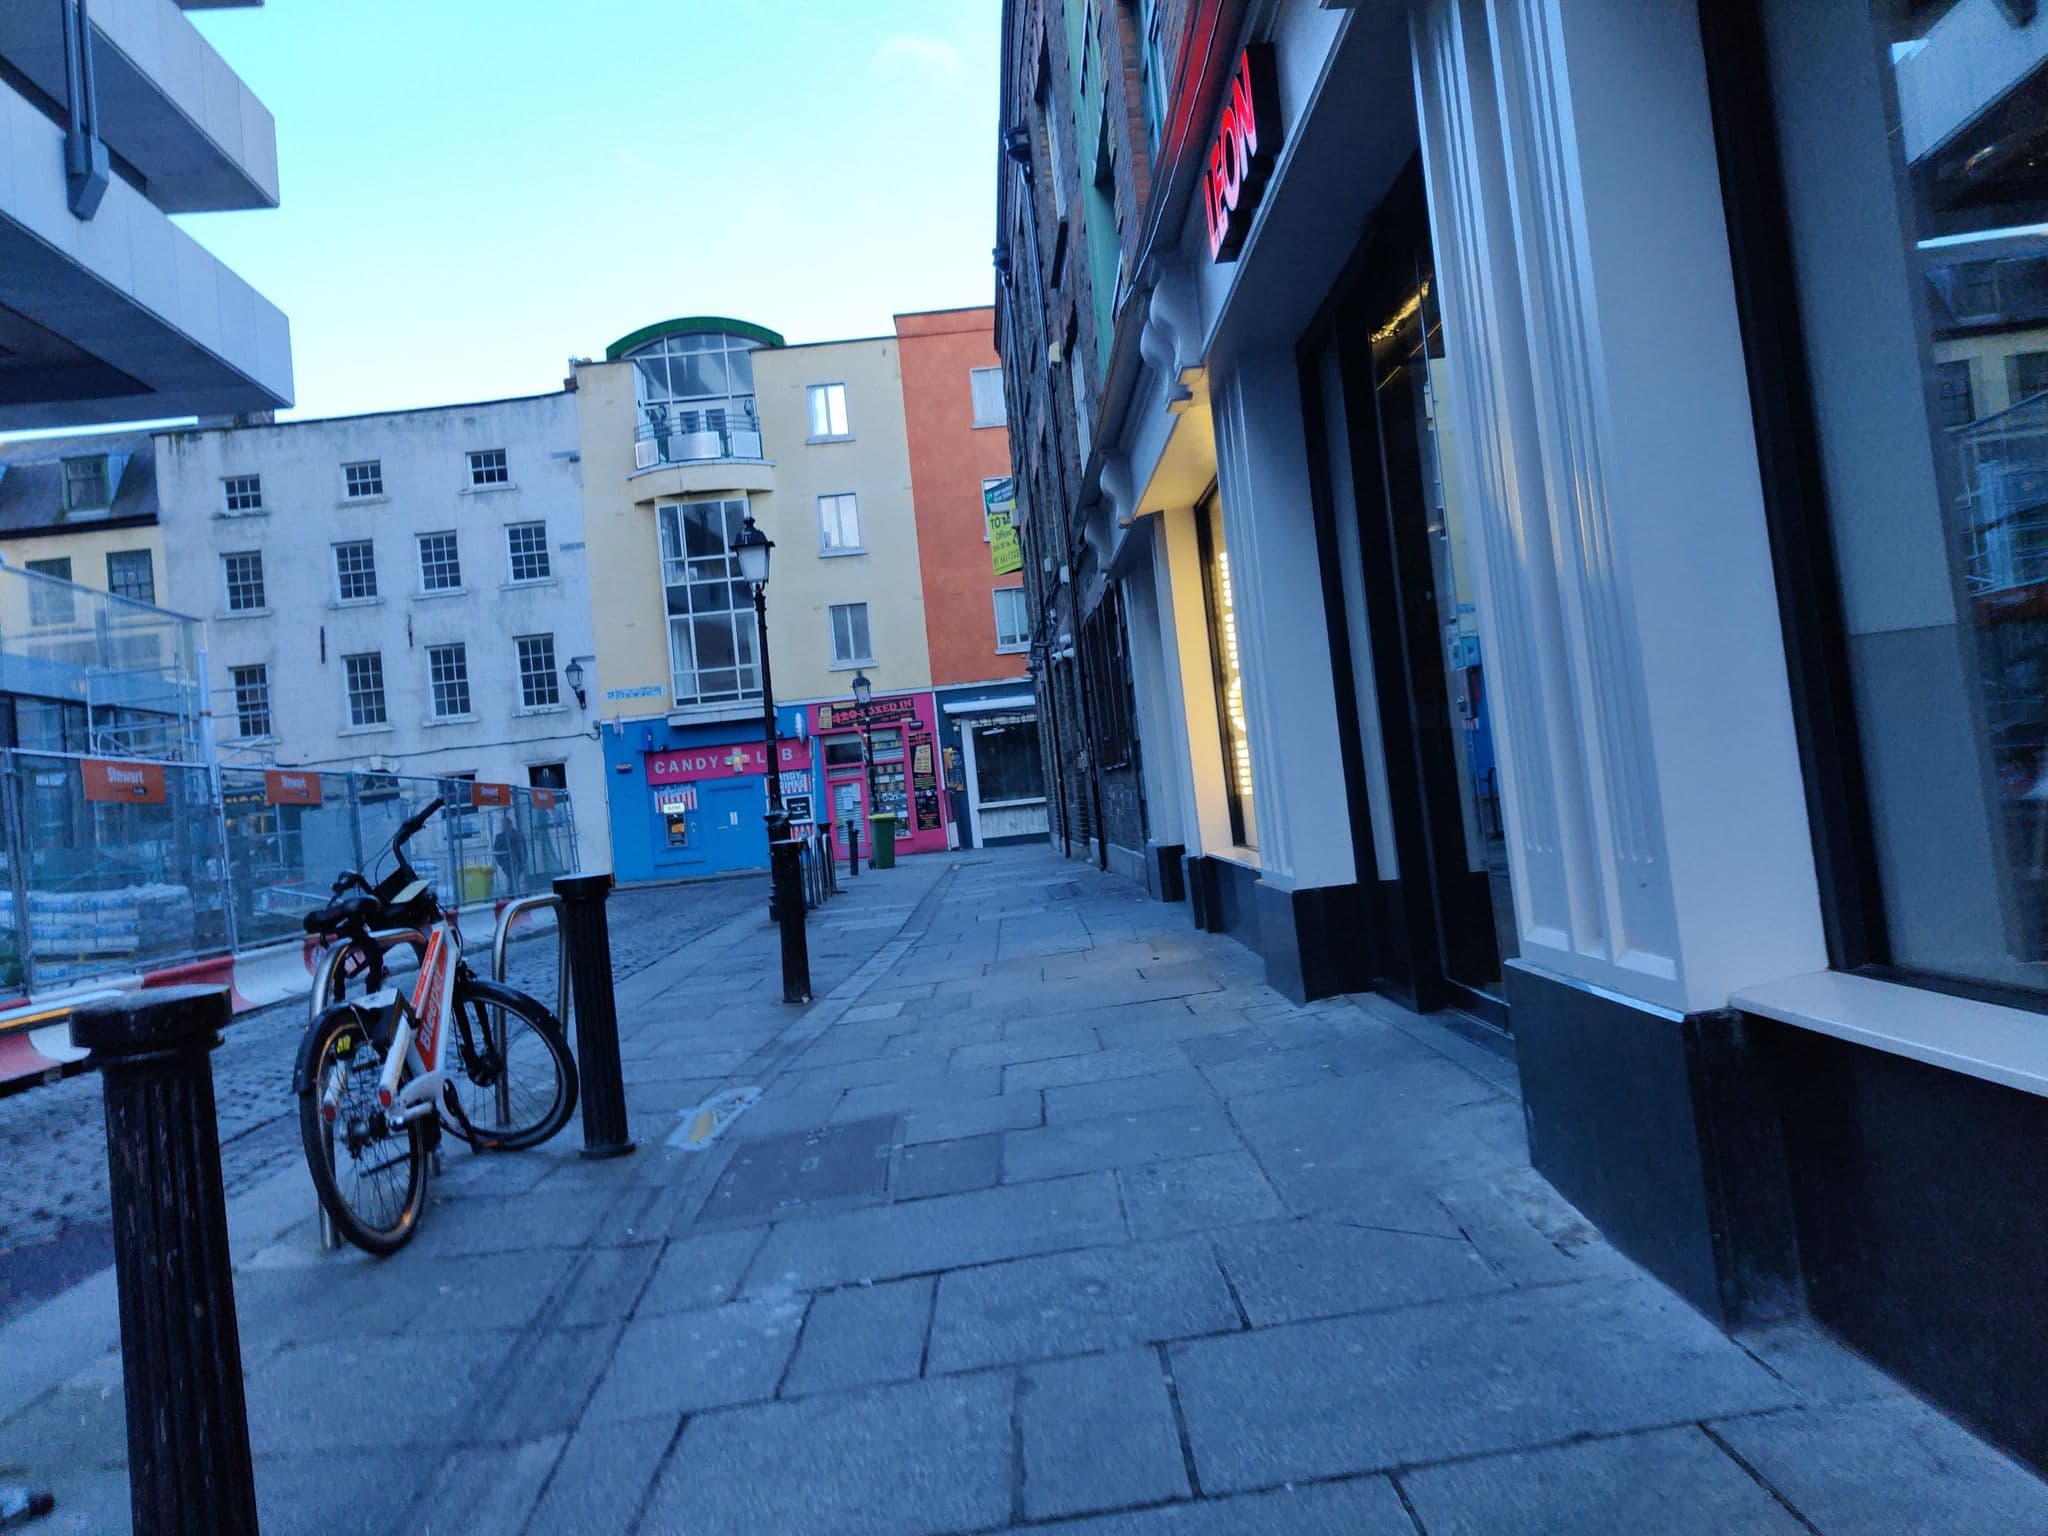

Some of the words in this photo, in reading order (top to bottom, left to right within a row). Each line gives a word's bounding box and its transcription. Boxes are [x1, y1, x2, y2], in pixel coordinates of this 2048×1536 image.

[1202, 49, 1258, 265] LEON
[899, 699, 912, 709] IN
[654, 756, 719, 775] CANDY
[756, 747, 793, 764] LB
[106, 766, 144, 785] Stewart
